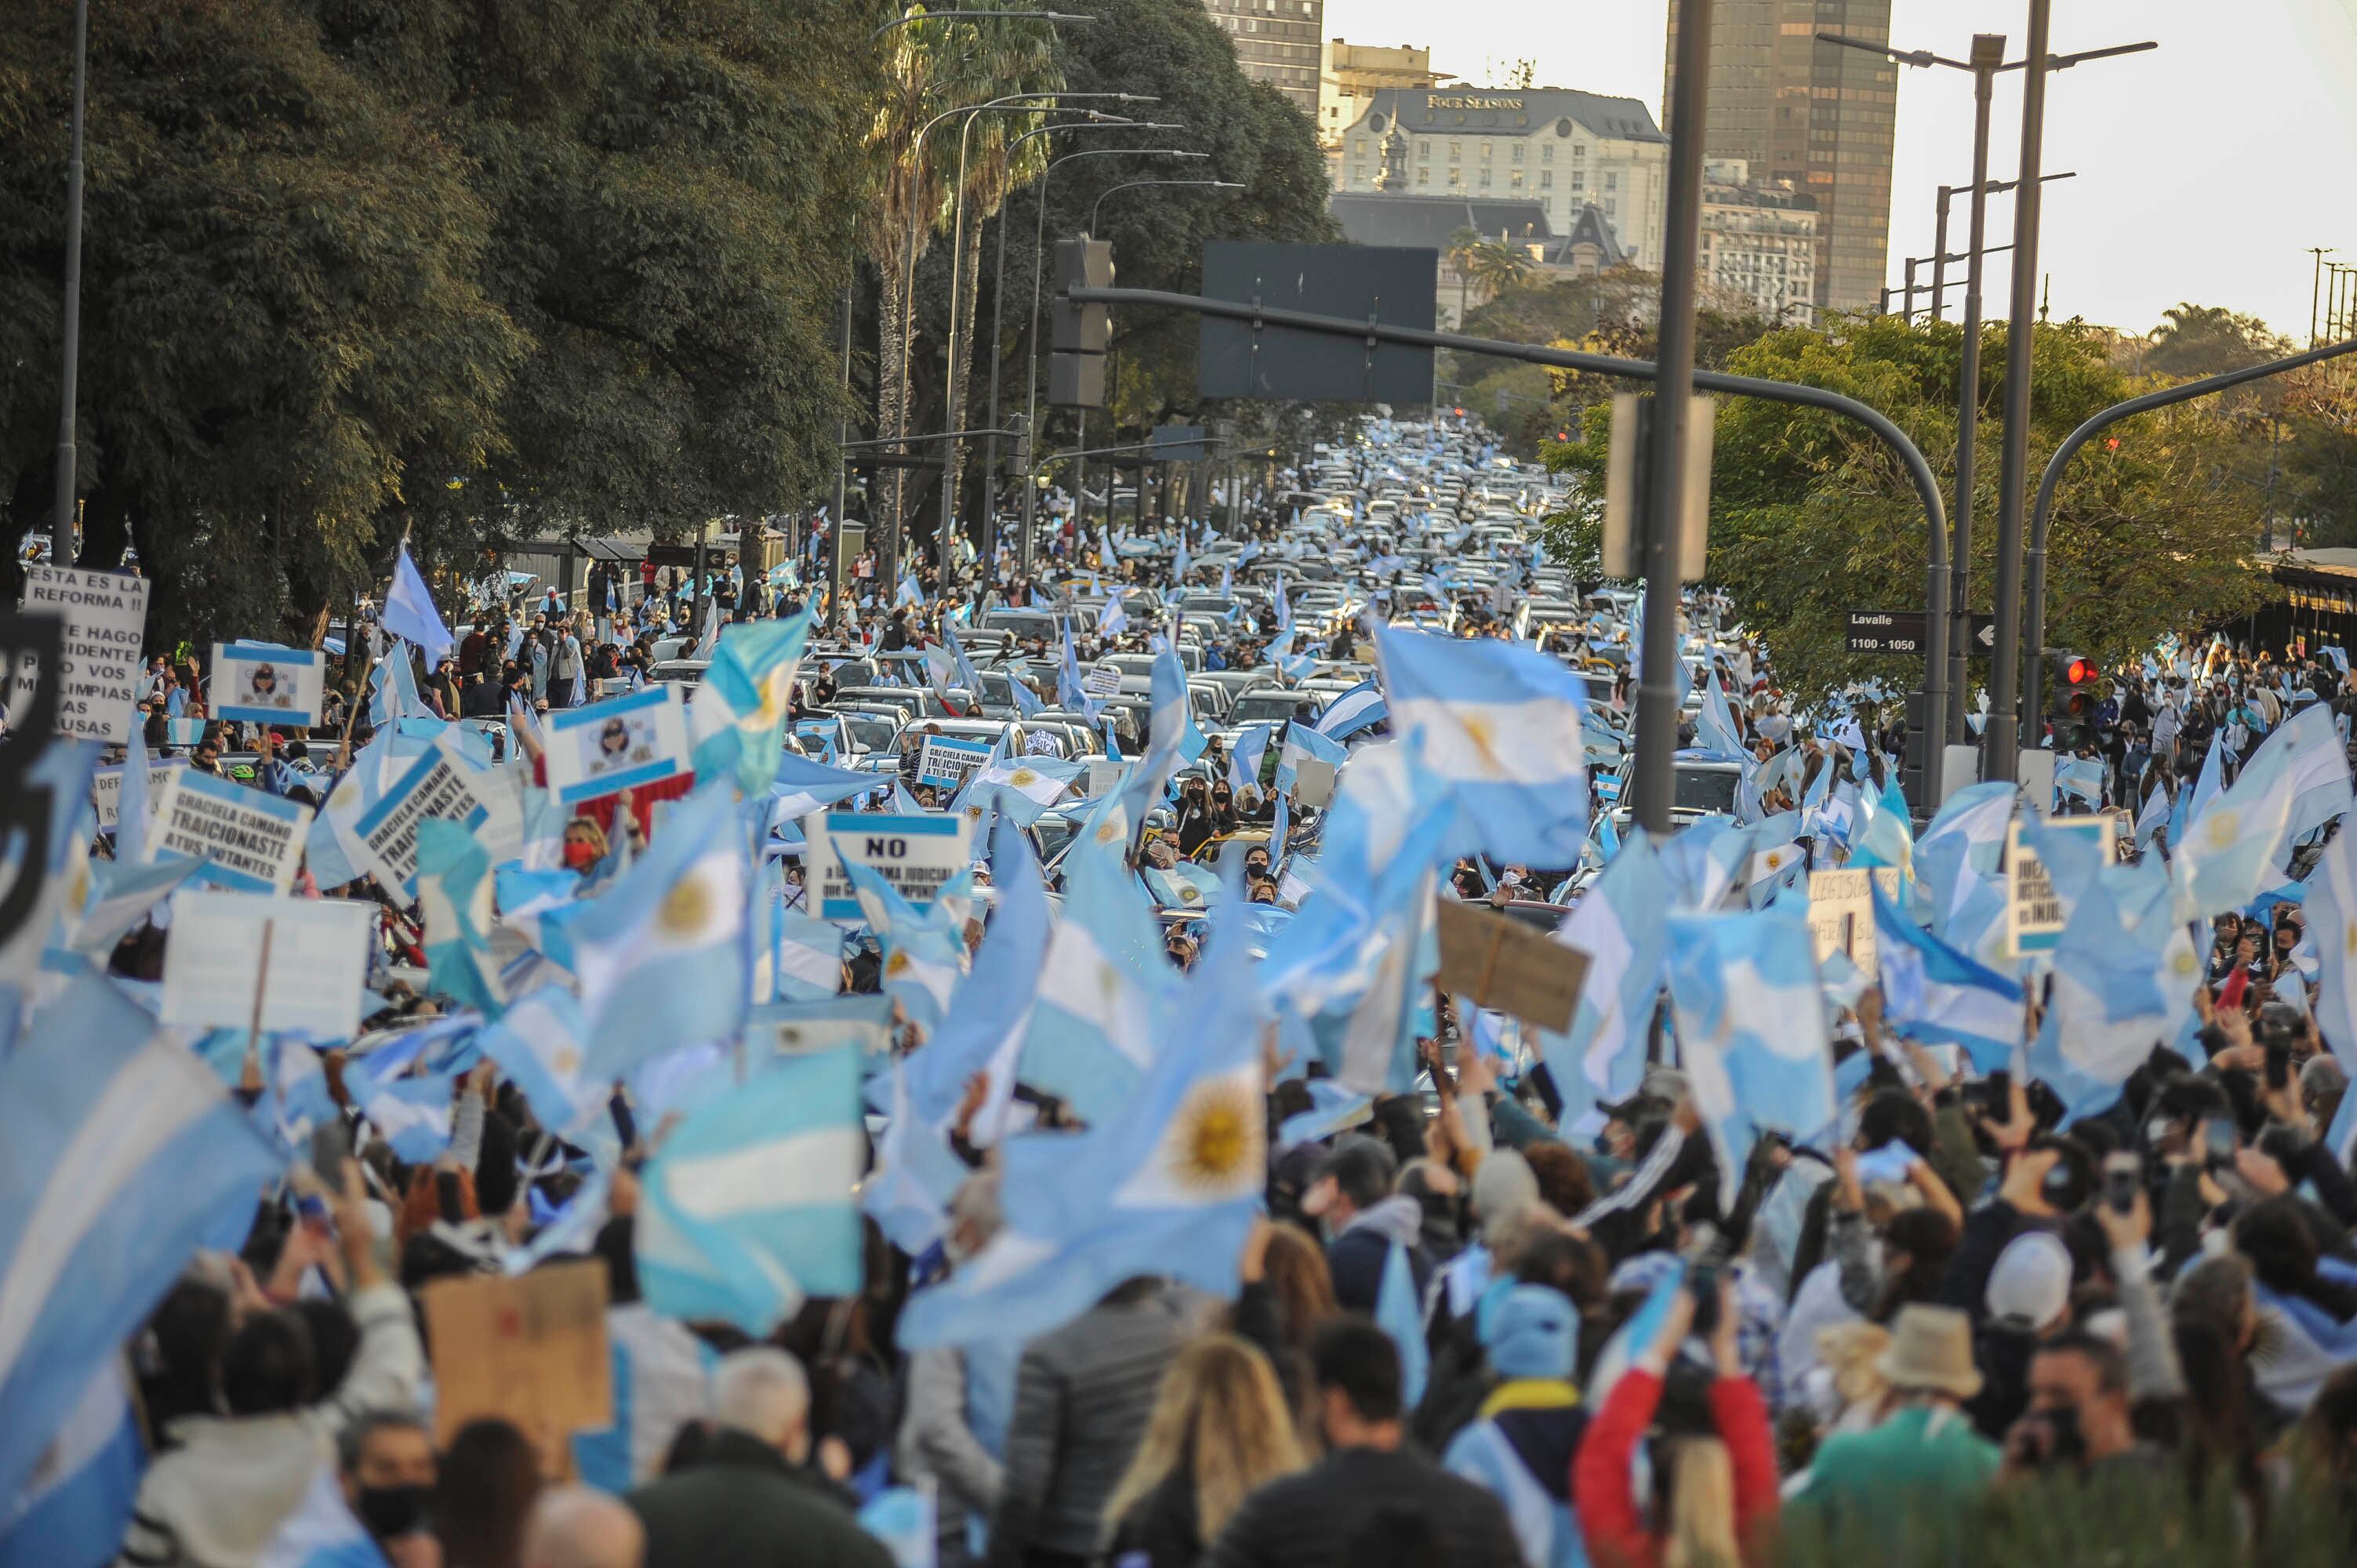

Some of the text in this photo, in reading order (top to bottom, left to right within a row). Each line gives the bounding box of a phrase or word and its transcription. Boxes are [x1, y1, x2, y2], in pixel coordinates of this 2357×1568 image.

[1428, 94, 1522, 109] FOUR SEASONS
[29, 568, 143, 593] ESTA ES LA
[34, 588, 124, 609] REFORMA
[1851, 614, 1892, 625] Lavalle
[86, 626, 142, 644] HAGO
[1851, 638, 1878, 649] 1100
[1889, 640, 1915, 650] 1050
[89, 665, 125, 681] VOS
[60, 718, 111, 735] USAS
[929, 749, 960, 760] GRACIELA
[176, 792, 238, 822] GRACIELA
[169, 809, 287, 861] TRAICIONASTE
[369, 804, 416, 851] GRACIELA
[866, 837, 907, 858] NO
